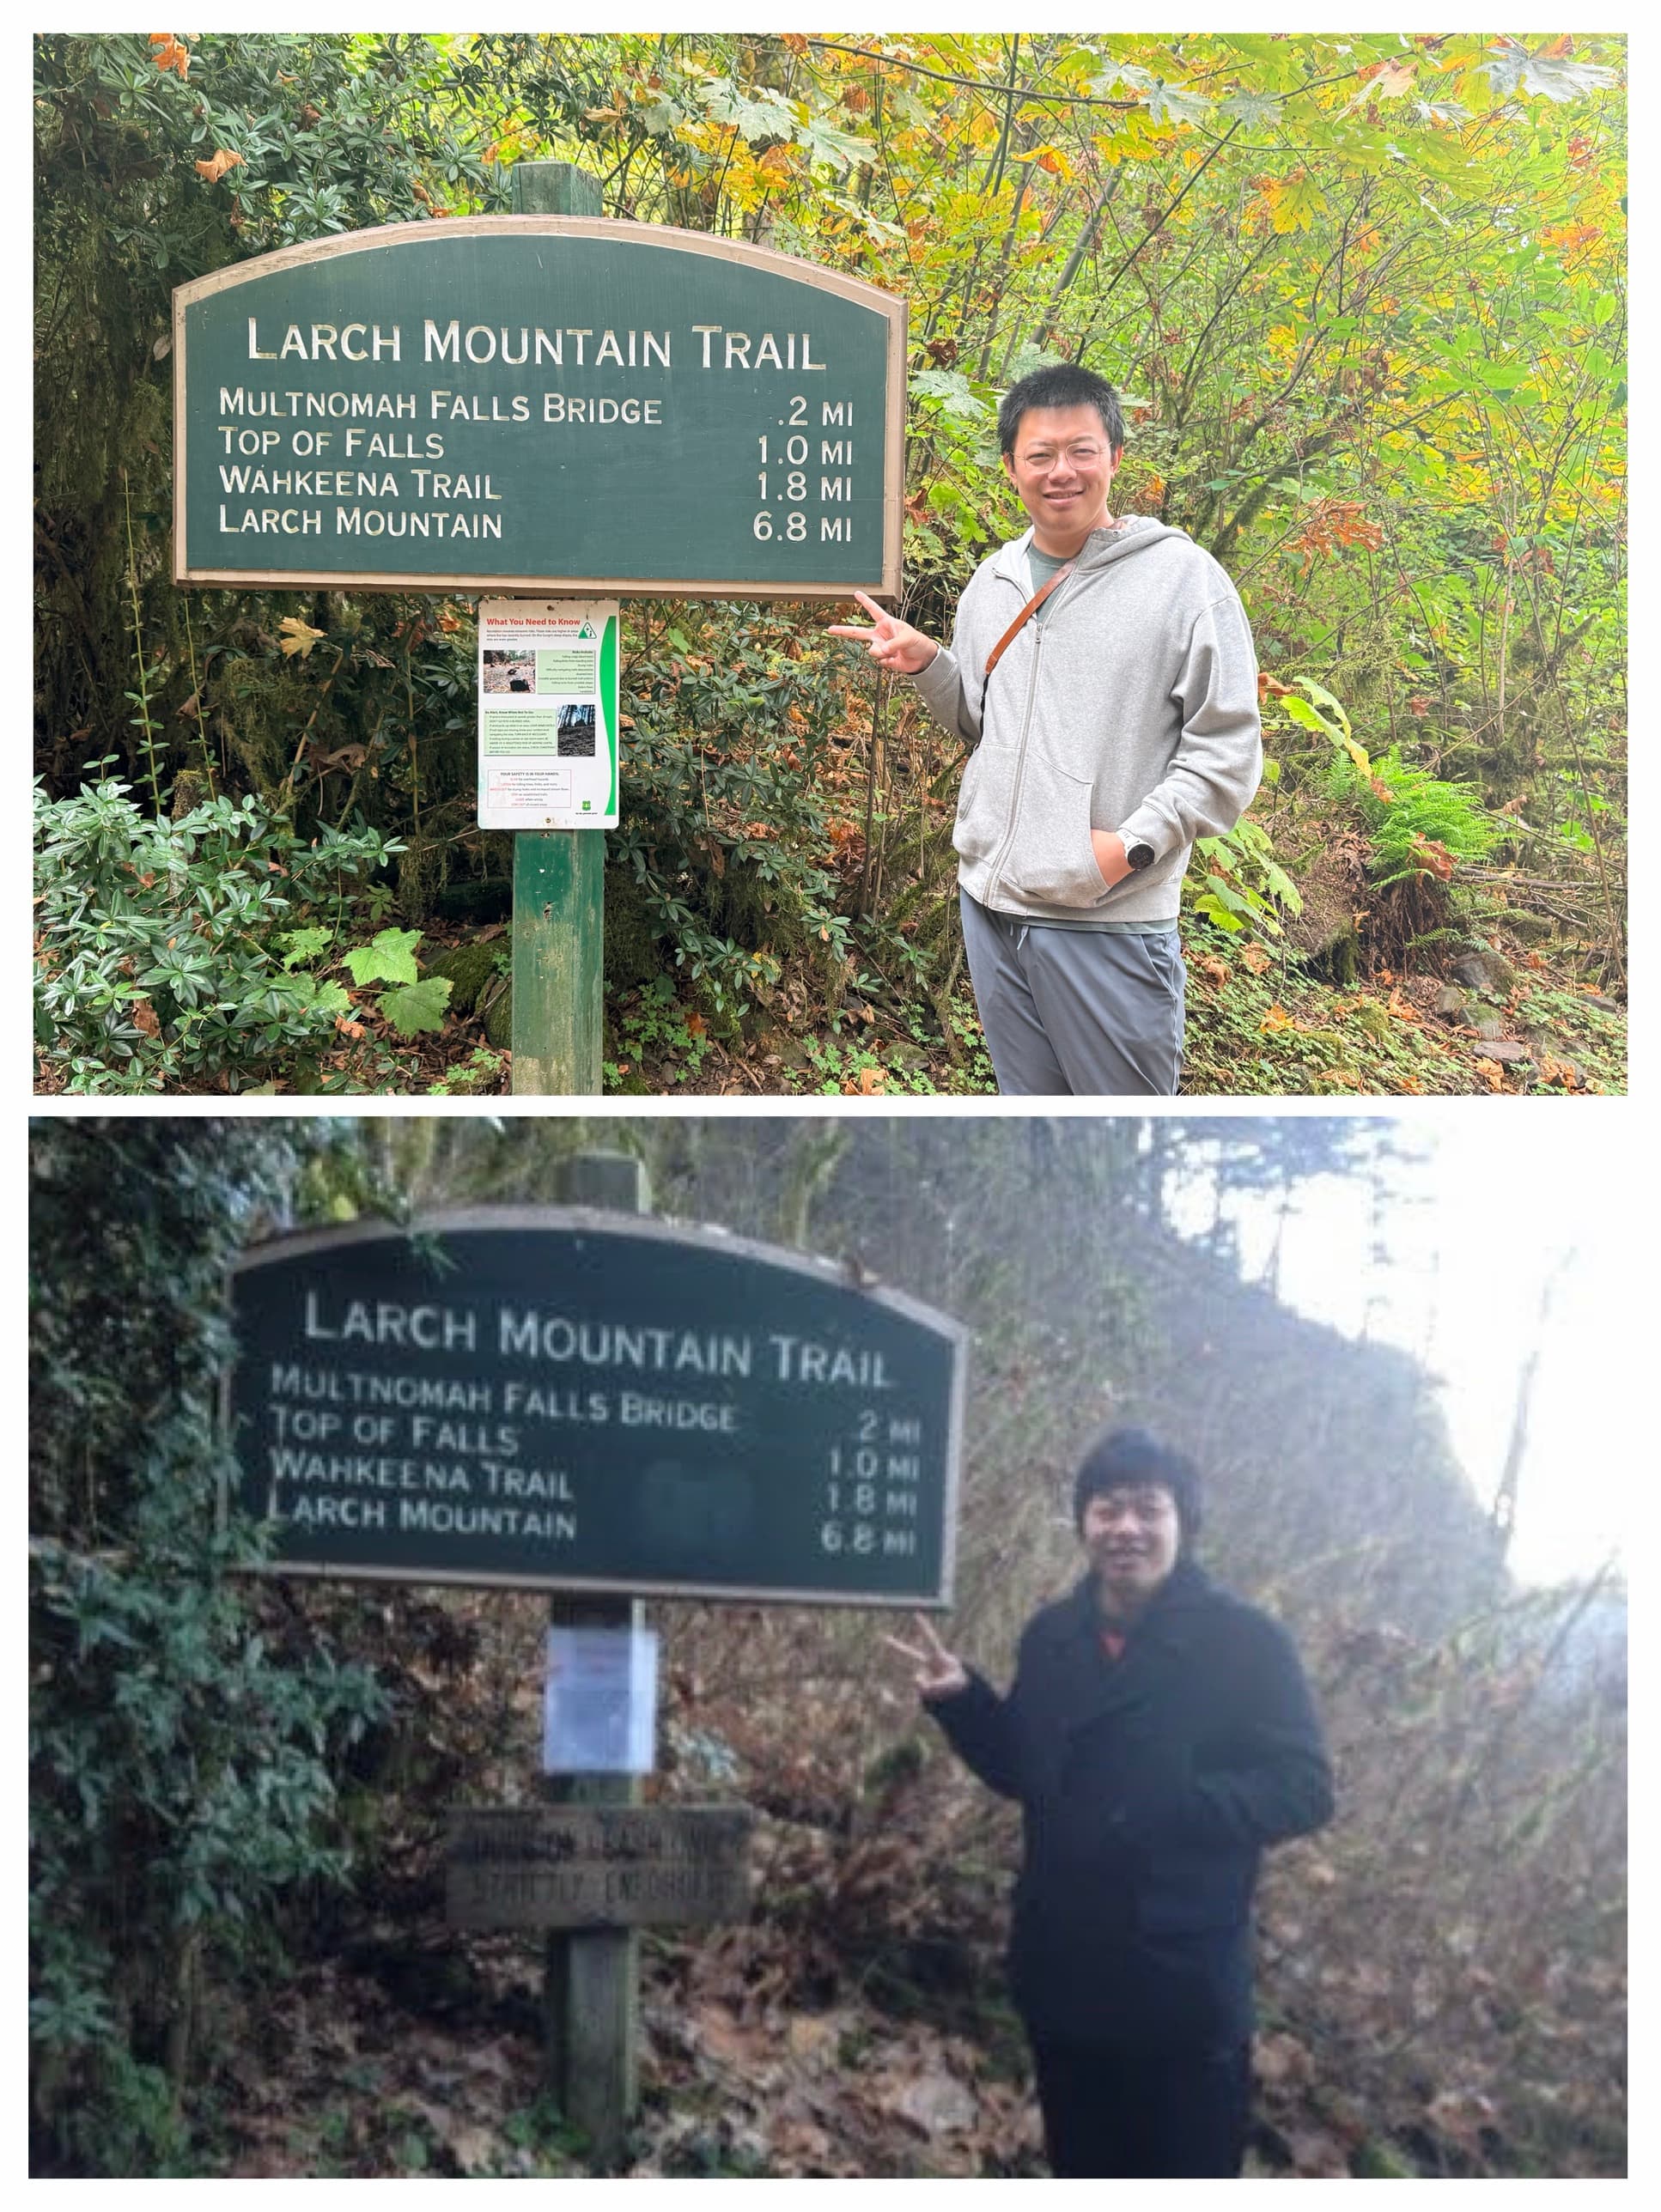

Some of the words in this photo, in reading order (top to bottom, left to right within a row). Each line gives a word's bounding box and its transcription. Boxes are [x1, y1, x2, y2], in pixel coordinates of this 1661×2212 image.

[248, 317, 400, 361] LARCH
[424, 319, 671, 368] MOUNTAIN
[691, 325, 826, 370] TRAIL
[220, 386, 416, 418] MULTNOMAH
[430, 390, 530, 422] FALLS
[543, 392, 662, 425] BRIDGE
[777, 395, 808, 427] .2
[822, 401, 853, 427] MI
[218, 426, 280, 455] TOP
[292, 429, 332, 456] OF
[345, 428, 445, 459] FALLS
[758, 434, 808, 465] 1.0
[821, 441, 852, 465] MI
[219, 465, 399, 496] WAHKEENA
[411, 469, 502, 500] TRAIL
[758, 471, 807, 501] 1.8
[821, 477, 851, 501] MI
[219, 504, 321, 534] LARCH
[337, 506, 502, 538] MOUNTAIN
[753, 510, 807, 541] 6.8
[821, 517, 851, 542] MI
[305, 1290, 476, 1352] LARCH
[499, 1307, 751, 1378] MOUNTAIN
[770, 1332, 891, 1388] TRAIL
[271, 1363, 491, 1412] MULTNOMAH
[504, 1382, 608, 1421] FALLS
[620, 1390, 737, 1433] BRIDGE
[270, 1402, 342, 1446] TOP
[353, 1414, 395, 1444] OF
[412, 1416, 519, 1457] FALLS
[269, 1447, 471, 1491] WAHKEENA
[481, 1461, 573, 1499] TRAIL
[267, 1488, 385, 1528] LARCH
[400, 1498, 577, 1540] MOUNTAIN
